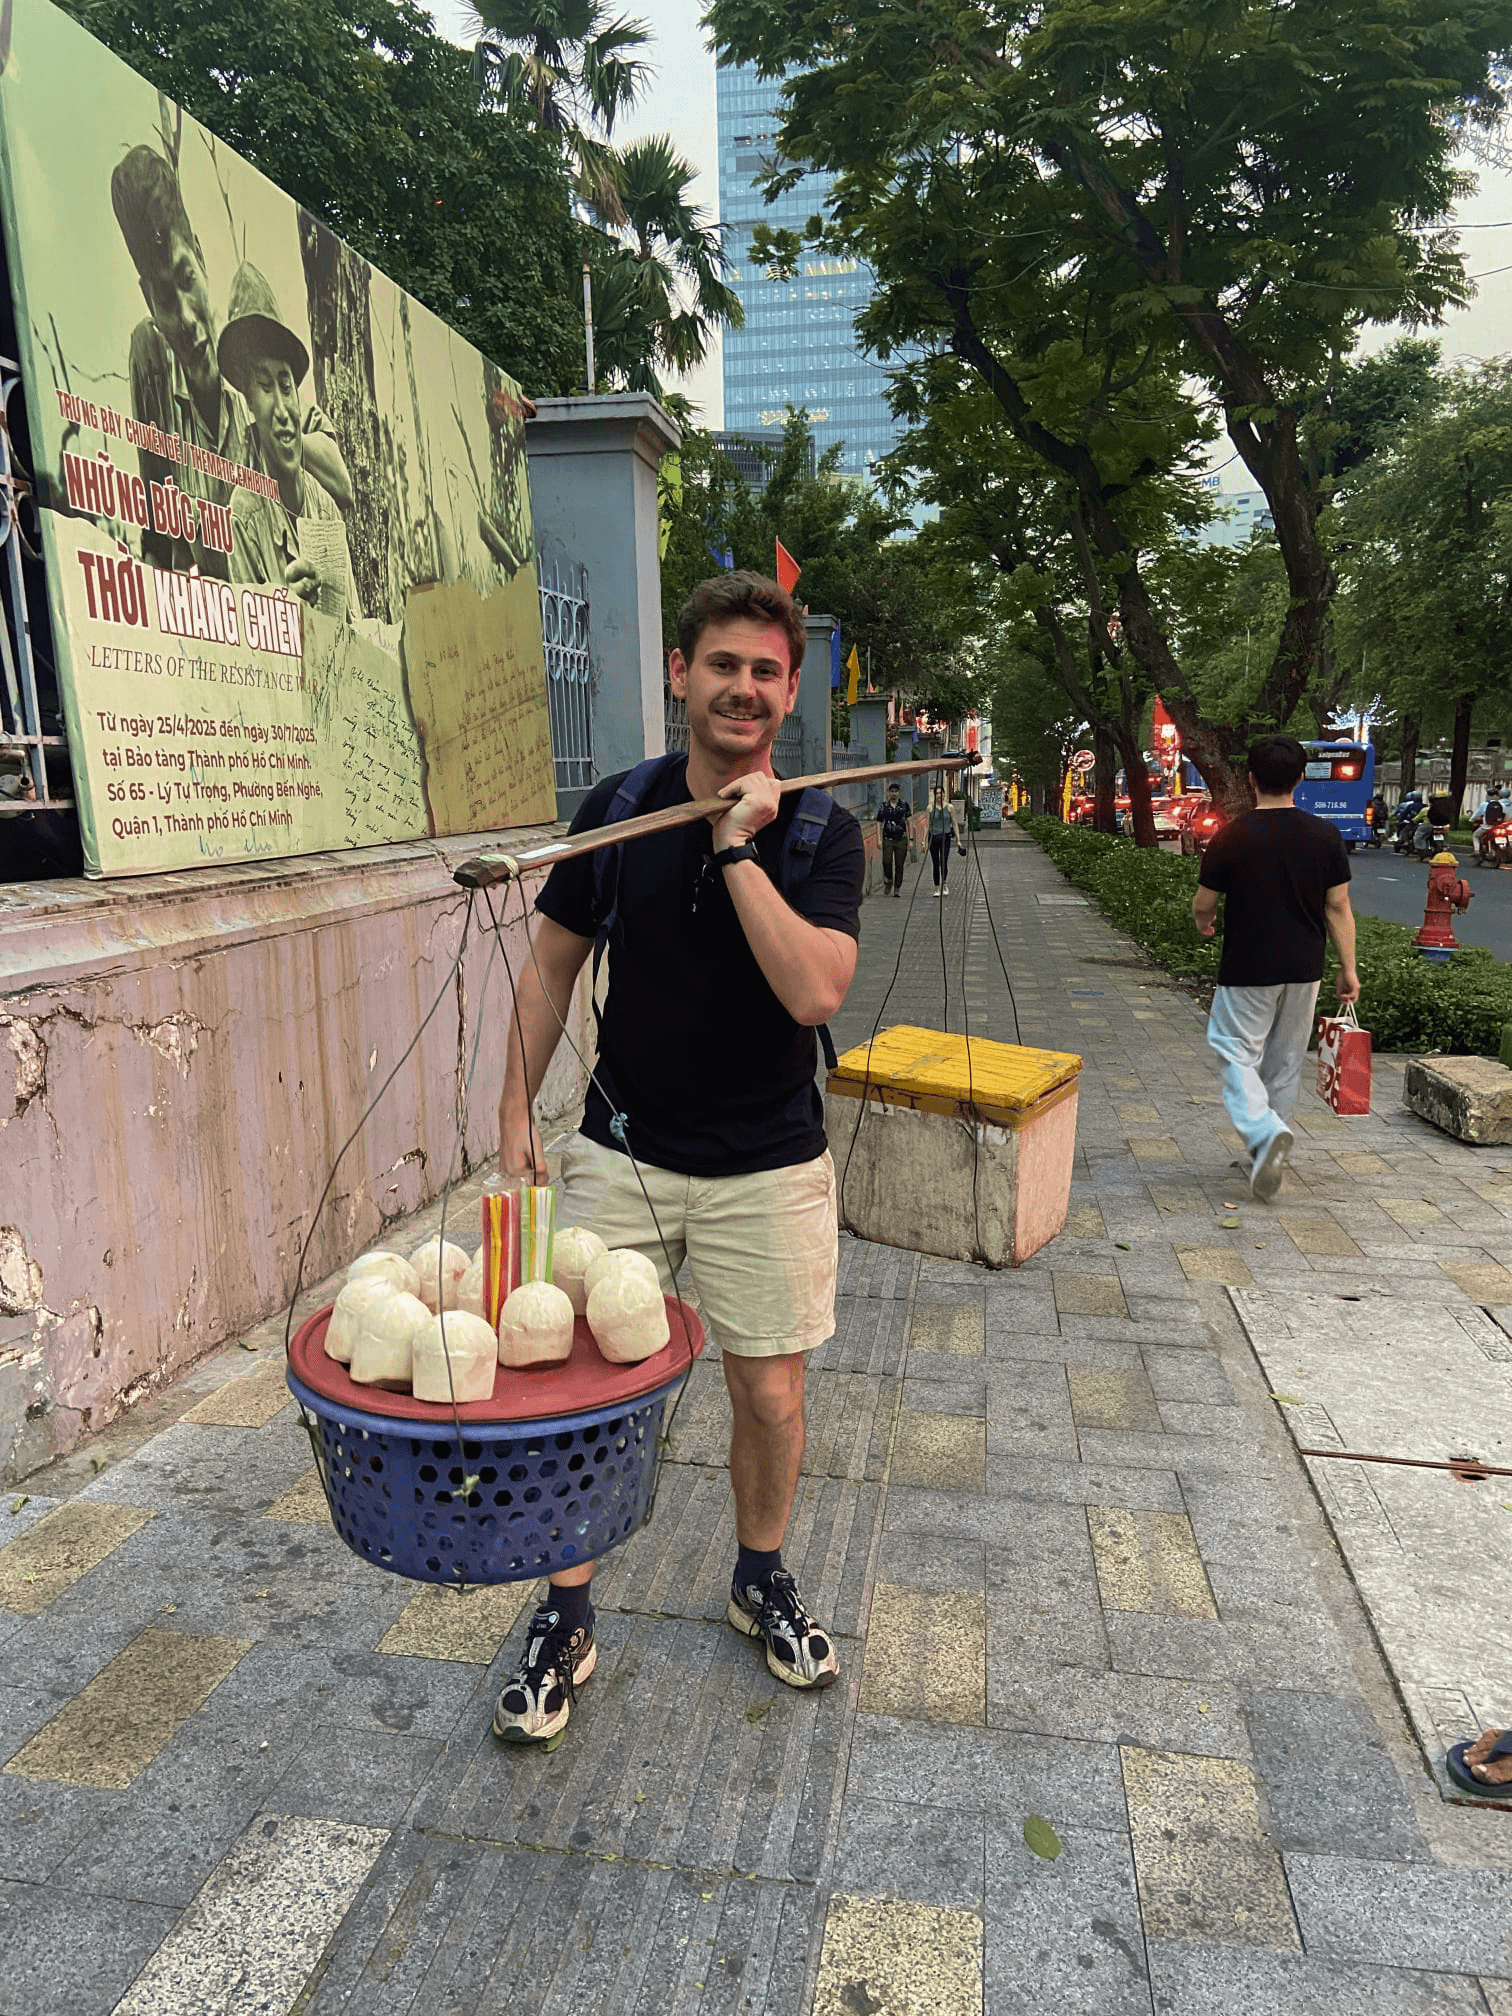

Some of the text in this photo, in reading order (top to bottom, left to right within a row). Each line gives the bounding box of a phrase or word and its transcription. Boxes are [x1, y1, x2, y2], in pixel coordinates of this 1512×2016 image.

[56, 389, 99, 430] TRƯNG
[99, 404, 121, 439] BÀY
[124, 420, 167, 458] CHUYÊN
[189, 443, 237, 485] THEMATIC
[236, 463, 281, 502] EXHIBITION
[63, 451, 234, 555] NHỮNG BỨC THƯ
[77, 539, 303, 657] THỜI KHÁNG CHIẾN
[91, 645, 319, 695] LETTERS OF THE RESISTANCE WAR
[96, 711, 318, 745] Từ ngày 25/4/2025 đến ngày 30/7/2025,
[102, 746, 122, 772] tại
[125, 745, 153, 767] Bảo
[155, 748, 186, 772] tàng
[187, 749, 225, 768] Thành
[228, 750, 249, 772] phố
[251, 751, 266, 769] Hồ
[268, 753, 285, 769] Chí
[107, 780, 126, 801] Số
[129, 783, 146, 801] 65
[157, 781, 172, 804] Lý
[174, 782, 191, 804] Tự
[192, 782, 231, 803] Trọng,
[233, 781, 274, 801] Phường
[276, 780, 295, 798] Bến
[296, 781, 323, 800] Nghé,
[112, 809, 293, 839] Quận 1, Thành phố Hồ Chí Minh
